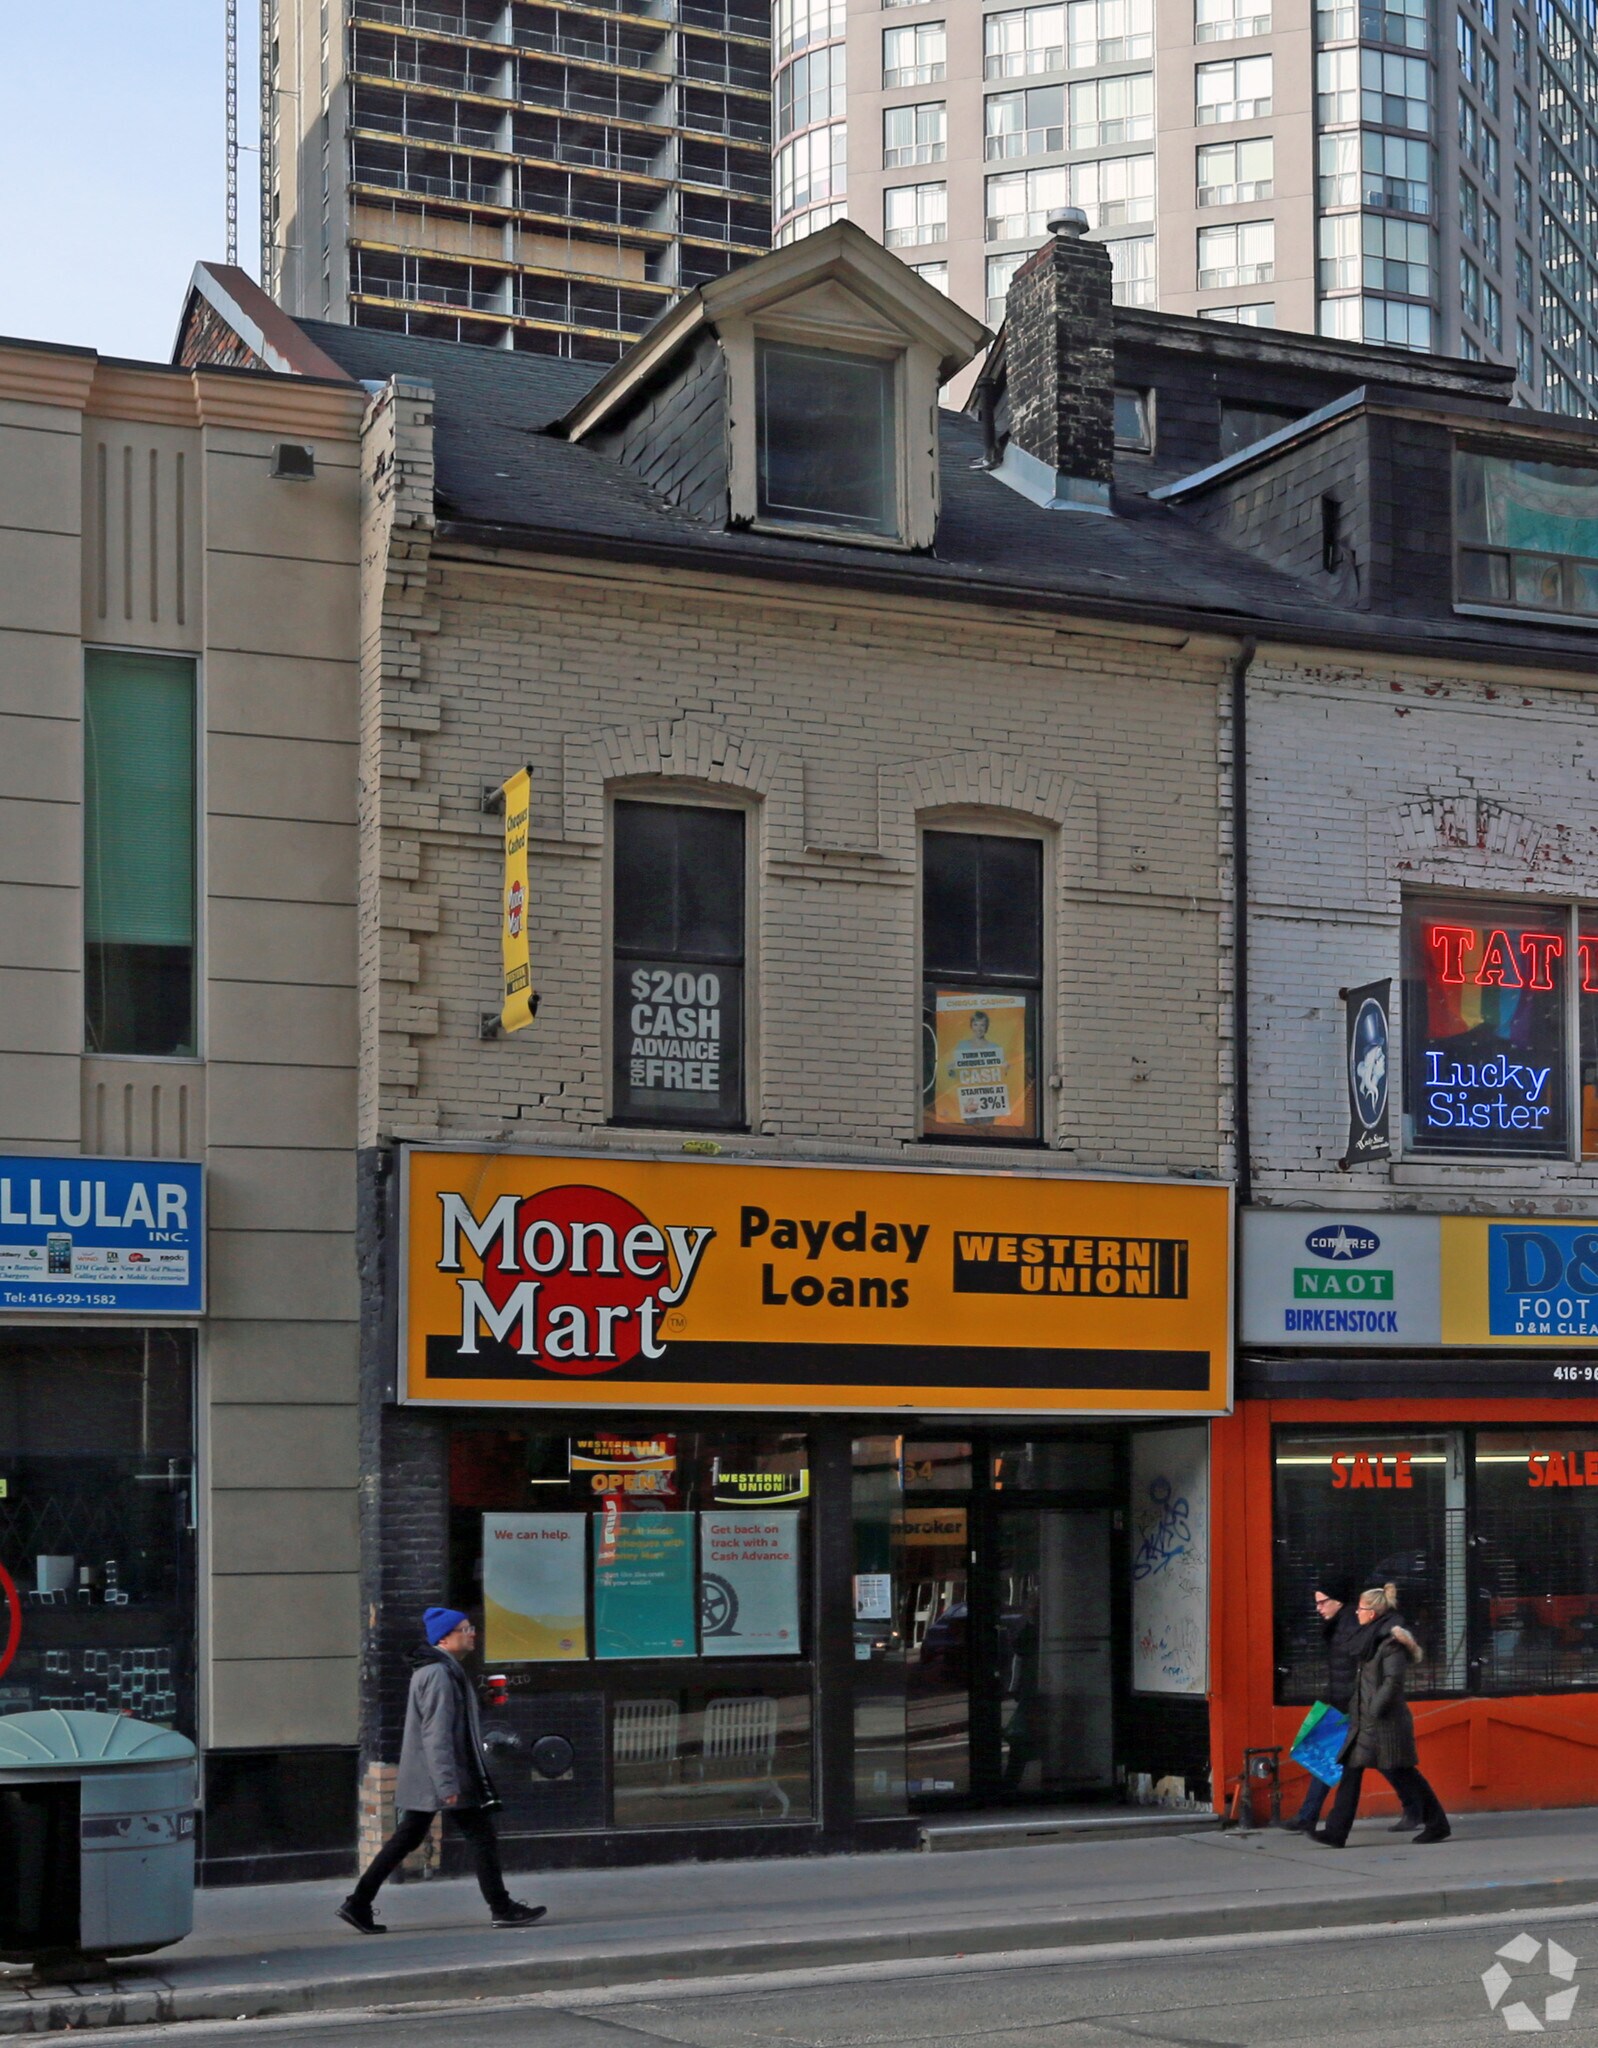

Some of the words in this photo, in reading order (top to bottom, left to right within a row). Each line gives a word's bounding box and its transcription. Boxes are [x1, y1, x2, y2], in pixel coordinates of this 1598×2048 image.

[507, 808, 528, 833] Cheques
[508, 830, 526, 856] Cashed
[631, 968, 720, 1006] $200
[631, 1005, 720, 1039] CASH
[631, 1038, 720, 1061] ADVANCE
[962, 1052, 979, 1060] TURN
[980, 1051, 996, 1059] YOUR
[630, 1059, 645, 1087] FOR
[957, 1059, 985, 1067] CHEQUES
[646, 1061, 720, 1091] FREE
[960, 1068, 1001, 1085] CASH
[1425, 1051, 1551, 1101] Lucky
[961, 1087, 994, 1097] STARTING
[996, 1086, 1005, 1094] AT
[980, 1096, 1006, 1110] 3%!
[1428, 1091, 1550, 1130] Sister
[0, 1178, 188, 1230] LLULAR
[149, 1231, 190, 1243] INC.
[740, 1205, 931, 1263] Payday
[437, 1192, 716, 1309] Money
[958, 1235, 1151, 1268] WESTERN
[762, 1263, 910, 1309] Loans
[1021, 1265, 1151, 1295] UNION
[1301, 1274, 1386, 1295] NAOT
[4, 1292, 26, 1303] Tel:
[29, 1293, 117, 1305] 416-929-1582
[1518, 1298, 1591, 1319] FOOT
[456, 1278, 670, 1361] Mart
[1284, 1308, 1398, 1333] BIRKENSTOCK
[577, 1440, 630, 1449] WESTERN
[593, 1448, 630, 1456] UNION
[718, 1473, 783, 1483] WESTERN
[1331, 1451, 1414, 1489] SALE
[1528, 1451, 1598, 1487] SALE
[591, 1473, 656, 1491] OPEN
[738, 1482, 783, 1492] UNION
[495, 1529, 514, 1540] We
[516, 1531, 538, 1540] can
[542, 1528, 572, 1543] help.
[711, 1524, 731, 1535] Get
[735, 1524, 761, 1535] back
[764, 1526, 779, 1534] on
[711, 1538, 740, 1548] track
[743, 1537, 768, 1548] with
[771, 1540, 778, 1548] a
[711, 1551, 739, 1562] Cash
[741, 1551, 792, 1562] Advance.
